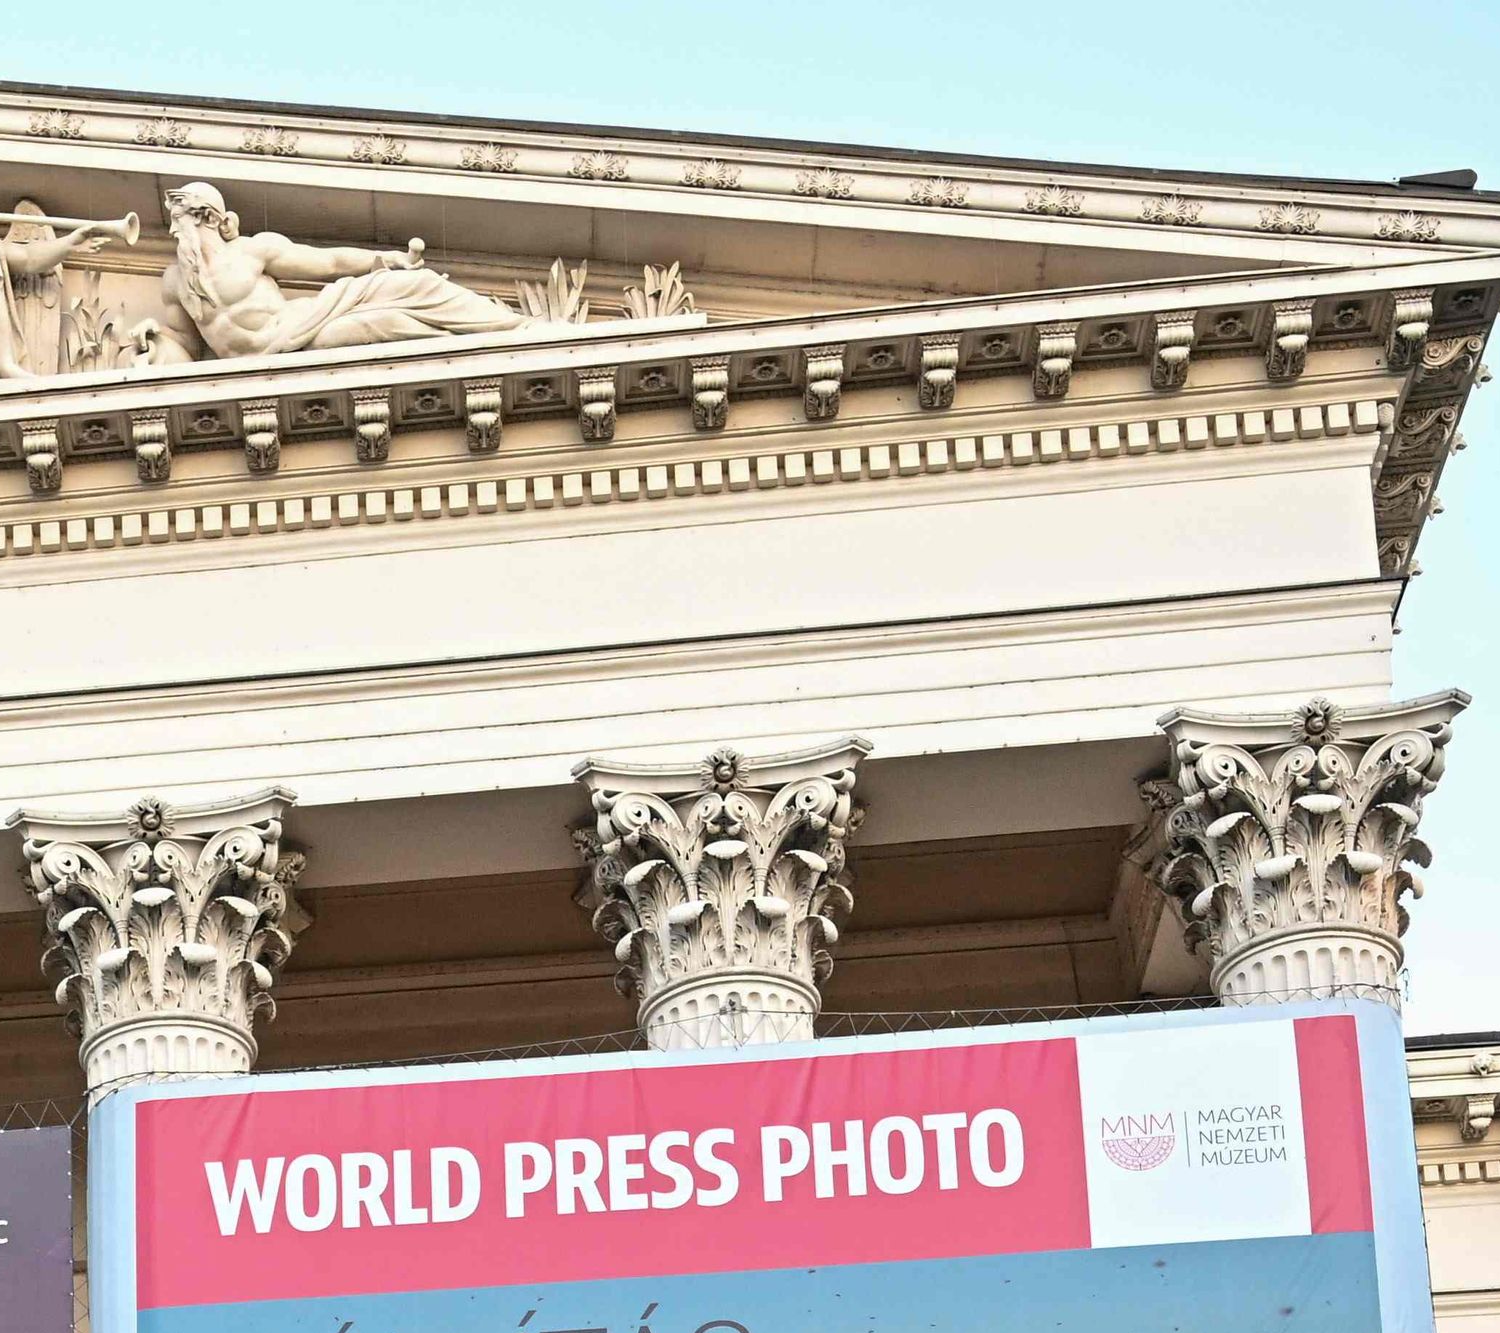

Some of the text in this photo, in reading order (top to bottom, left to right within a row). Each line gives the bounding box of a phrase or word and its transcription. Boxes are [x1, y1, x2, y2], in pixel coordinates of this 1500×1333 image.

[1101, 1112, 1176, 1138] MNM
[1198, 1104, 1283, 1125] MAGYAR
[1199, 1125, 1286, 1145] NEMZETI
[1201, 1146, 1288, 1167] MÚZEUM
[203, 1106, 1025, 1237] WORLD PRESS PHOTO
